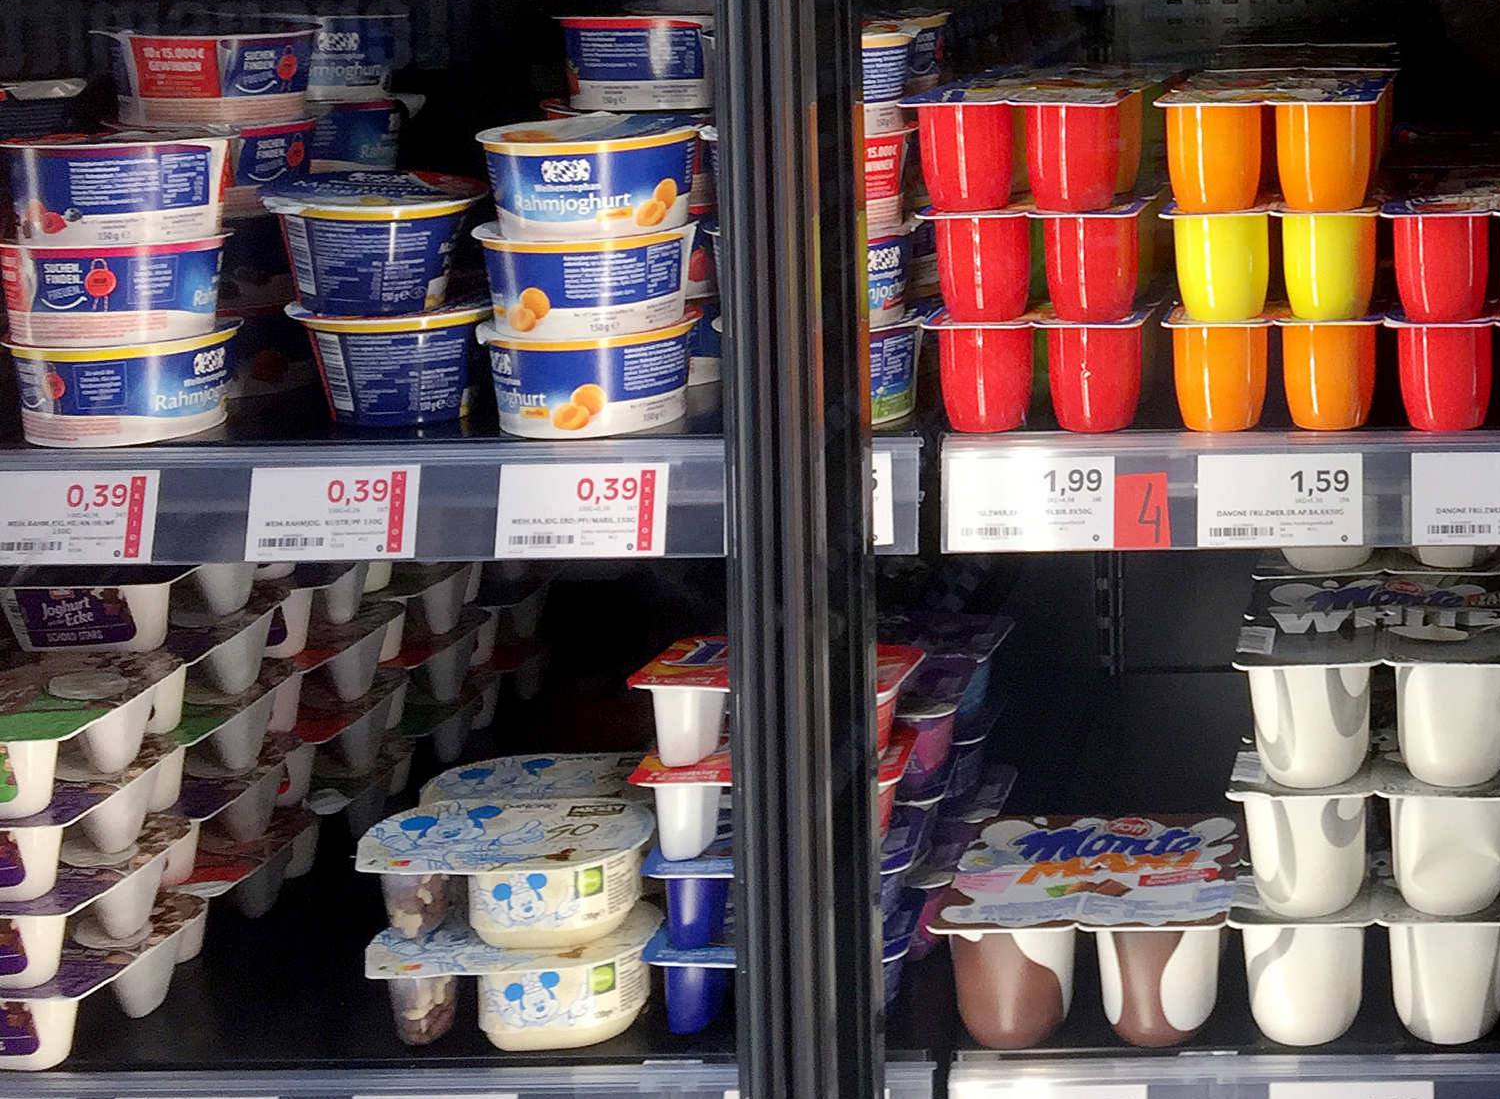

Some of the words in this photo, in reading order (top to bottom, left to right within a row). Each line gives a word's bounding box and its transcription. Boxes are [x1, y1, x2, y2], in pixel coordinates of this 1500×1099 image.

[513, 191, 632, 214] Rahmjoghurt
[327, 479, 389, 507] 0,39
[576, 477, 638, 504] 0,39
[1042, 467, 1102, 496] 1,99
[1289, 468, 1350, 497] 1,59
[66, 482, 128, 511] 0,39
[1136, 483, 1162, 543] 4
[42, 597, 91, 623] Joghurt
[65, 608, 95, 627] Ecke
[1010, 827, 1204, 863] Monte
